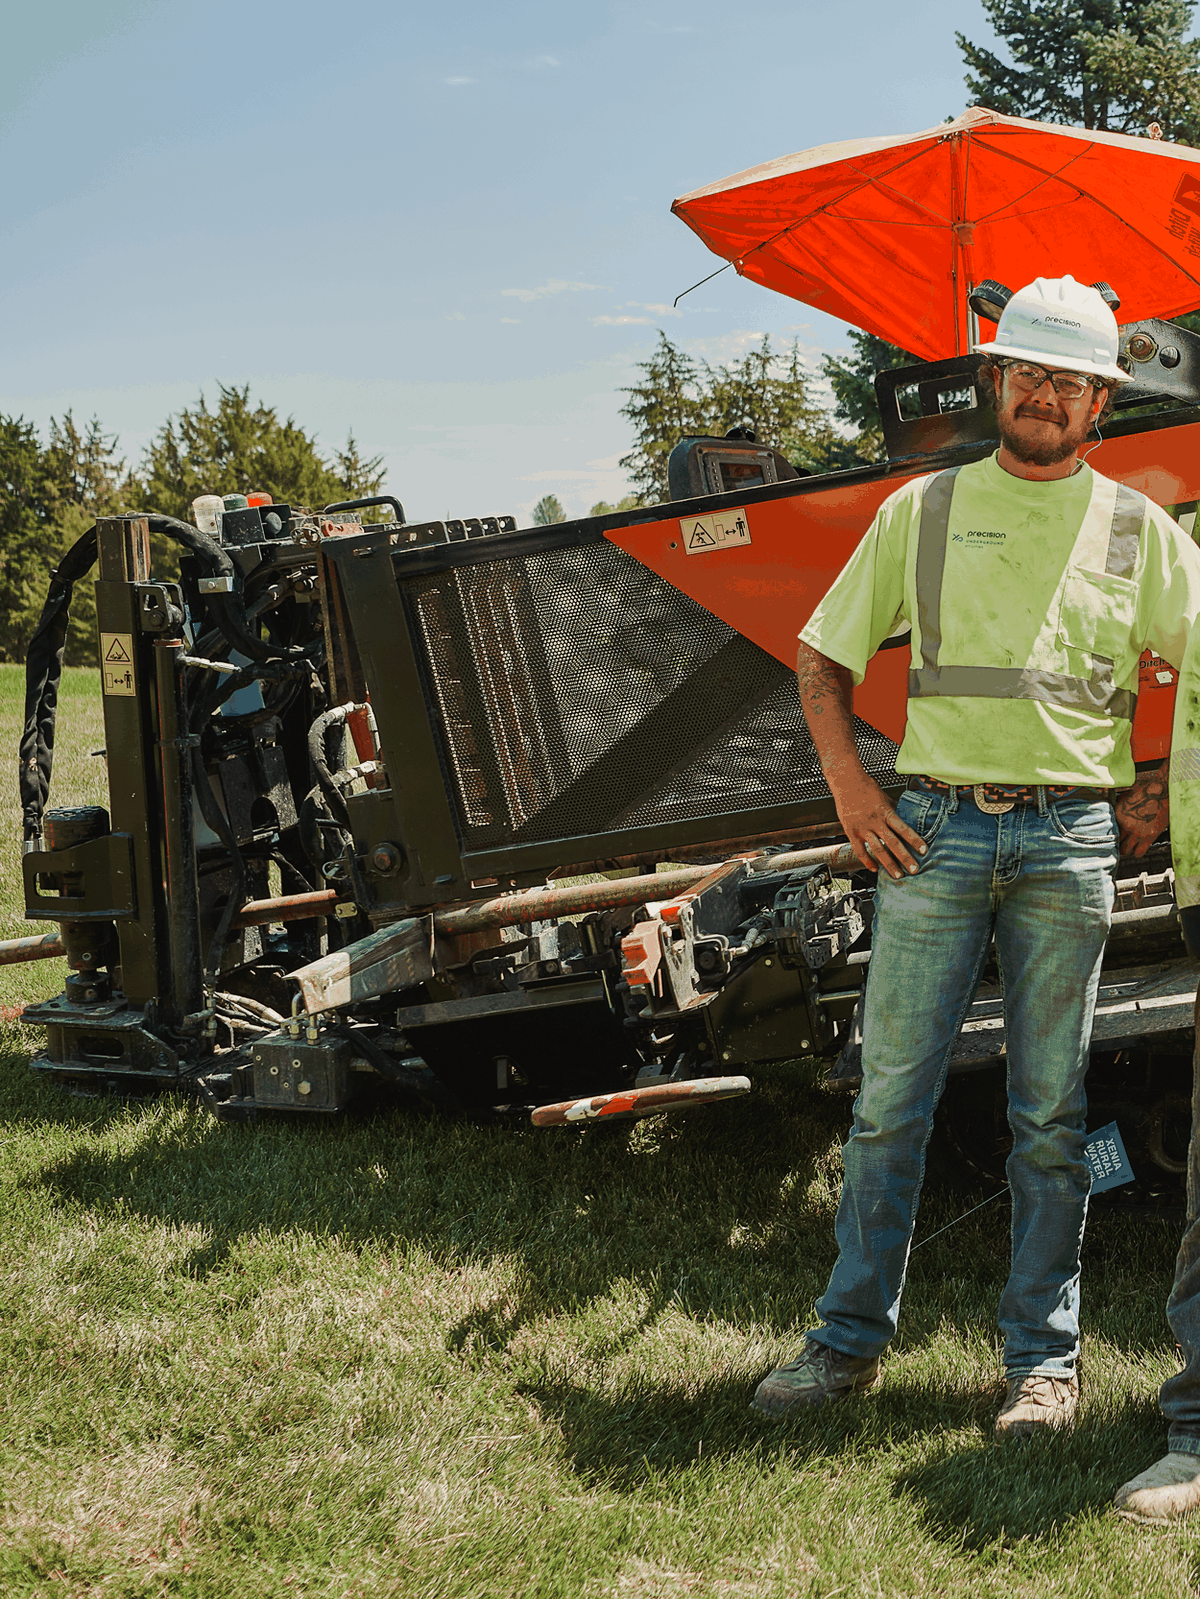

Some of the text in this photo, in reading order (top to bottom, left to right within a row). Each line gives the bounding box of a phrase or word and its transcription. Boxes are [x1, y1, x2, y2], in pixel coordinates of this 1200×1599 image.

[1044, 316, 1081, 328] precision
[966, 530, 1007, 539] precision
[1086, 1142, 1106, 1179] WATER
[1095, 1139, 1114, 1176] RURAL
[1105, 1137, 1122, 1171] XENIA
